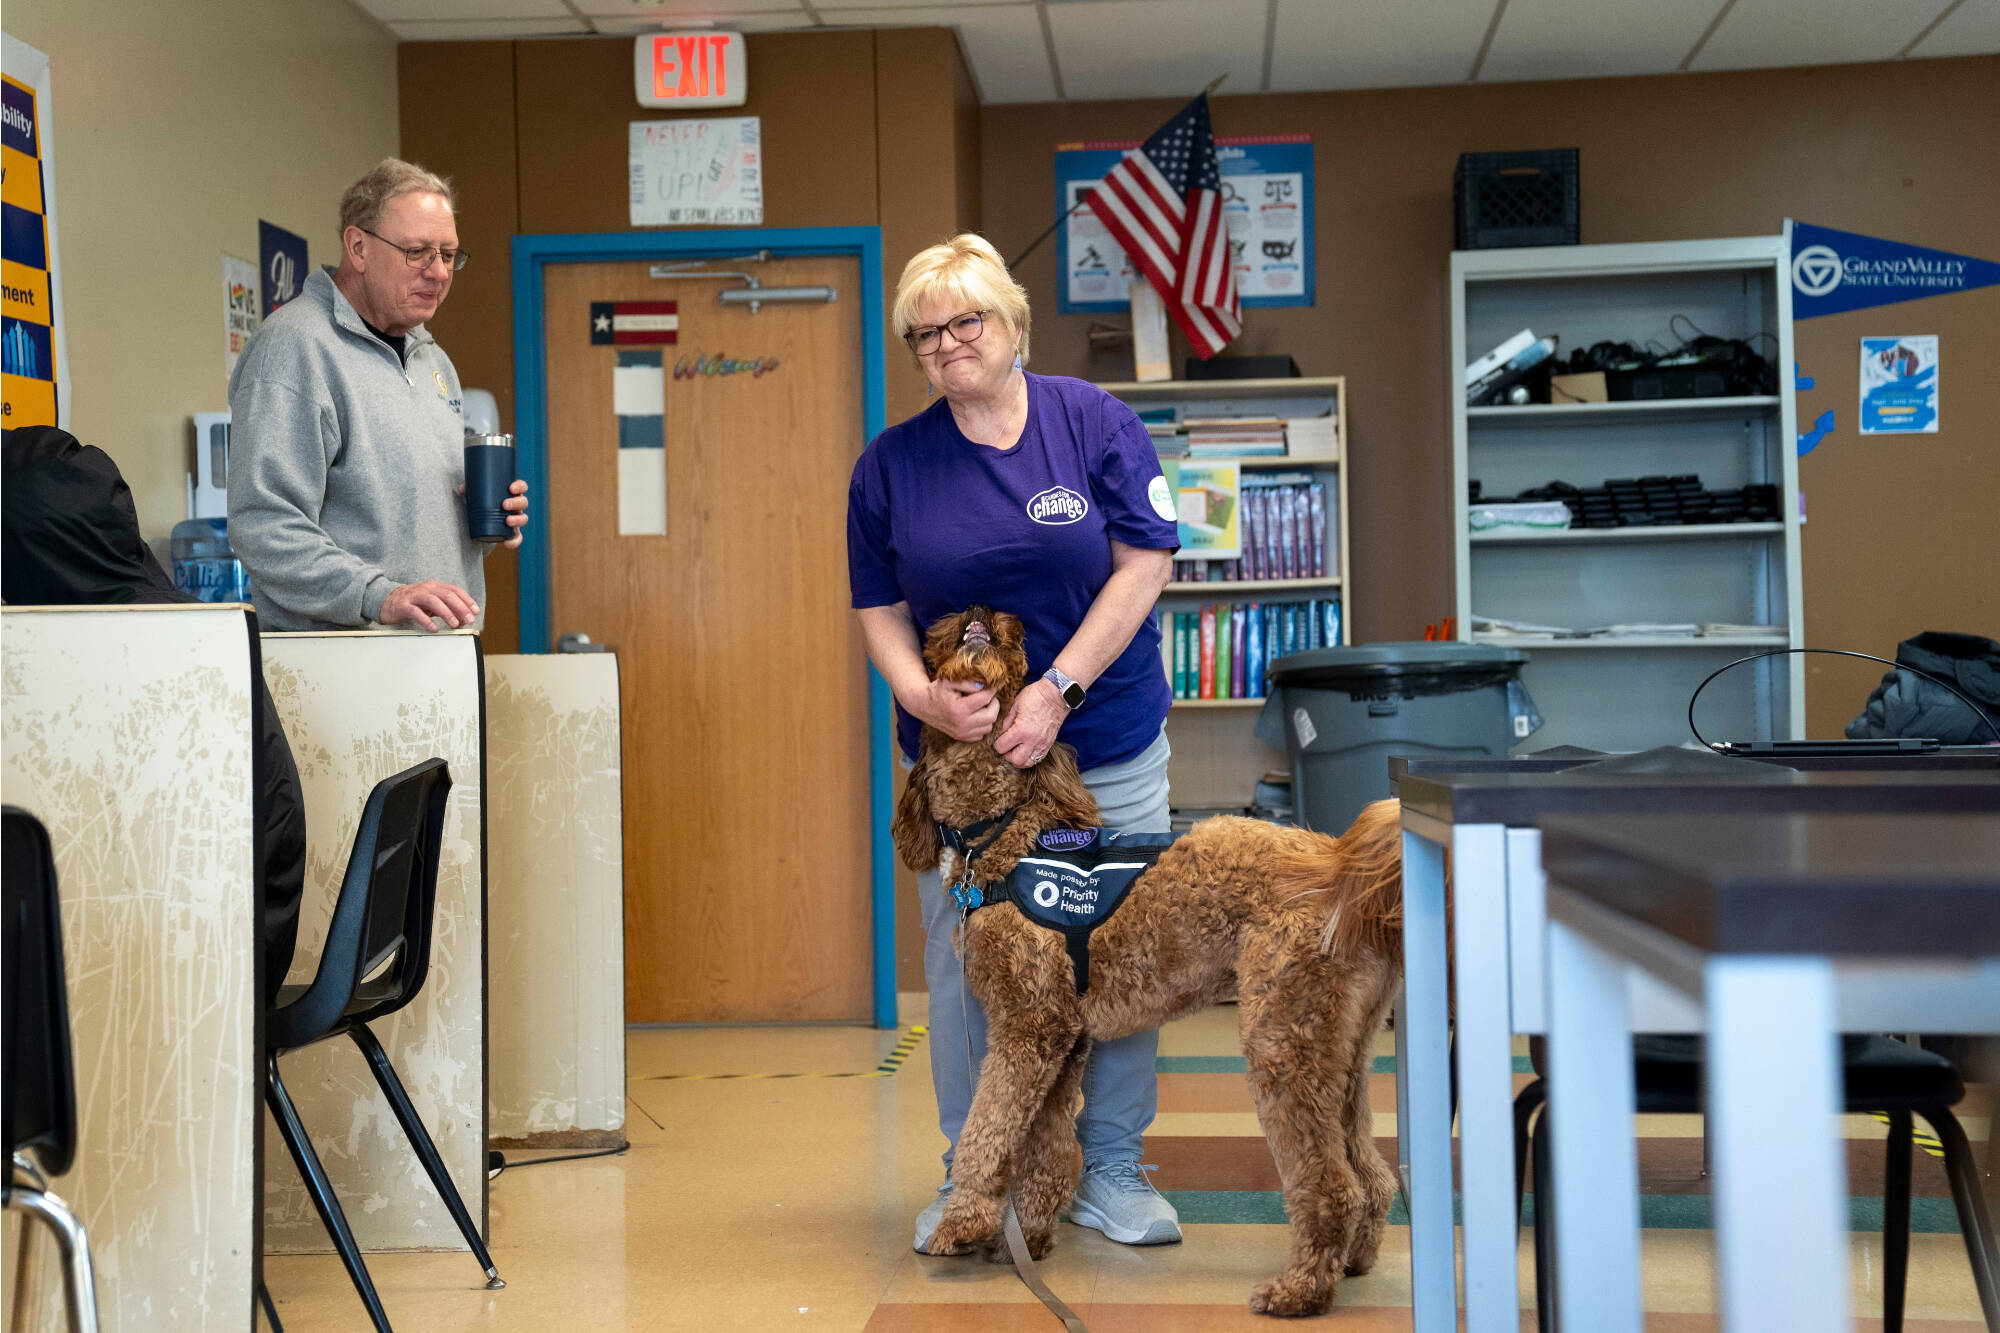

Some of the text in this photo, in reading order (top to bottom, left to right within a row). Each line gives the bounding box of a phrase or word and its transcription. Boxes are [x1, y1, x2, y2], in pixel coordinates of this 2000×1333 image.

[653, 36, 730, 98] EXIT
[1, 103, 32, 138] bility
[1843, 256, 1967, 274] GRAND VALLEY
[1842, 272, 1966, 287] STATE UNIVERSITY
[1034, 496, 1083, 520] change
[1042, 830, 1092, 845] change
[1036, 868, 1058, 879] Made
[1089, 877, 1100, 886] by
[1062, 886, 1099, 902] Priority
[1060, 900, 1095, 914] Health
